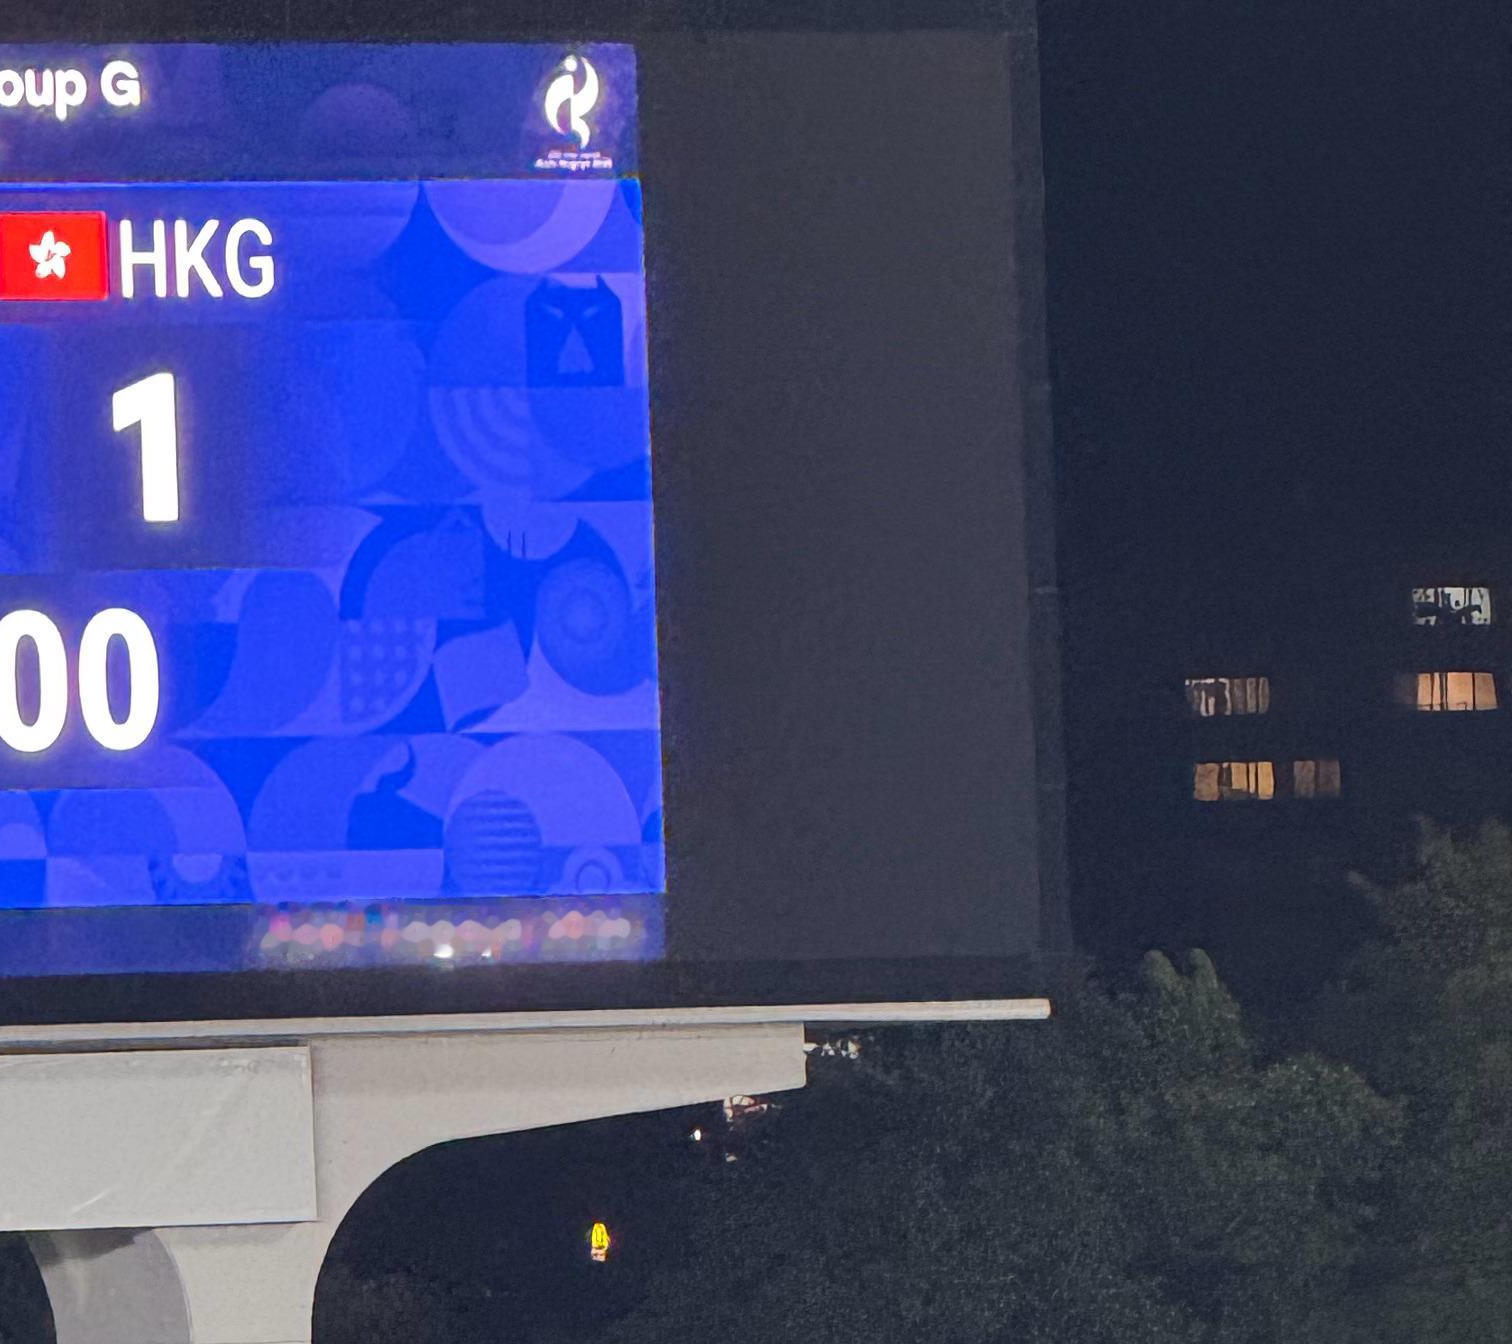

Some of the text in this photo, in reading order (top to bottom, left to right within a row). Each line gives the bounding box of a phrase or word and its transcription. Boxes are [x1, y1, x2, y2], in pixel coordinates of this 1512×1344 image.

[100, 60, 143, 108] G
[118, 218, 275, 299] HKG
[112, 372, 179, 523] 1
